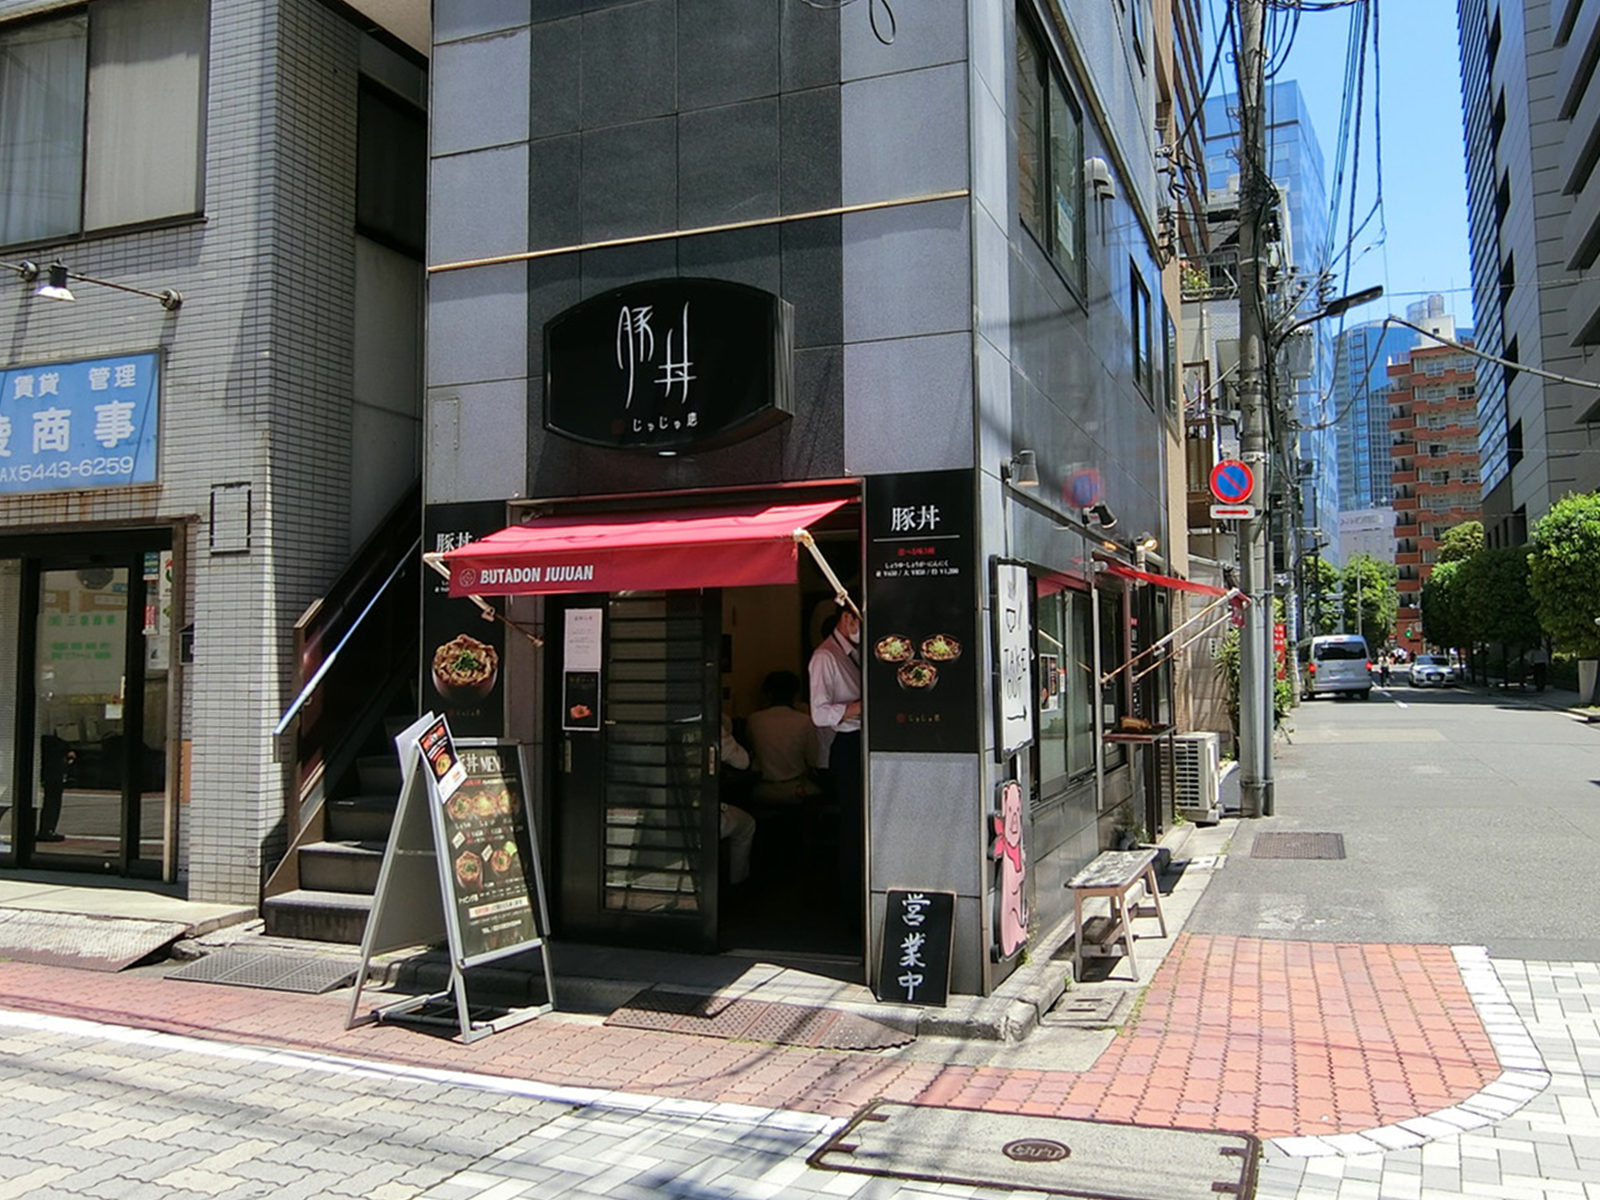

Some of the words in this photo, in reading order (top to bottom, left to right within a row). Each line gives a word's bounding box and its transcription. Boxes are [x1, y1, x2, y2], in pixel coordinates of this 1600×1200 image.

[616, 301, 697, 409] 豚丼
[89, 364, 136, 391] 管理
[891, 504, 941, 532] 豚丼
[480, 567, 541, 584] BUTADON
[545, 564, 594, 582] JUJUAN
[898, 893, 931, 1001] 営業中
